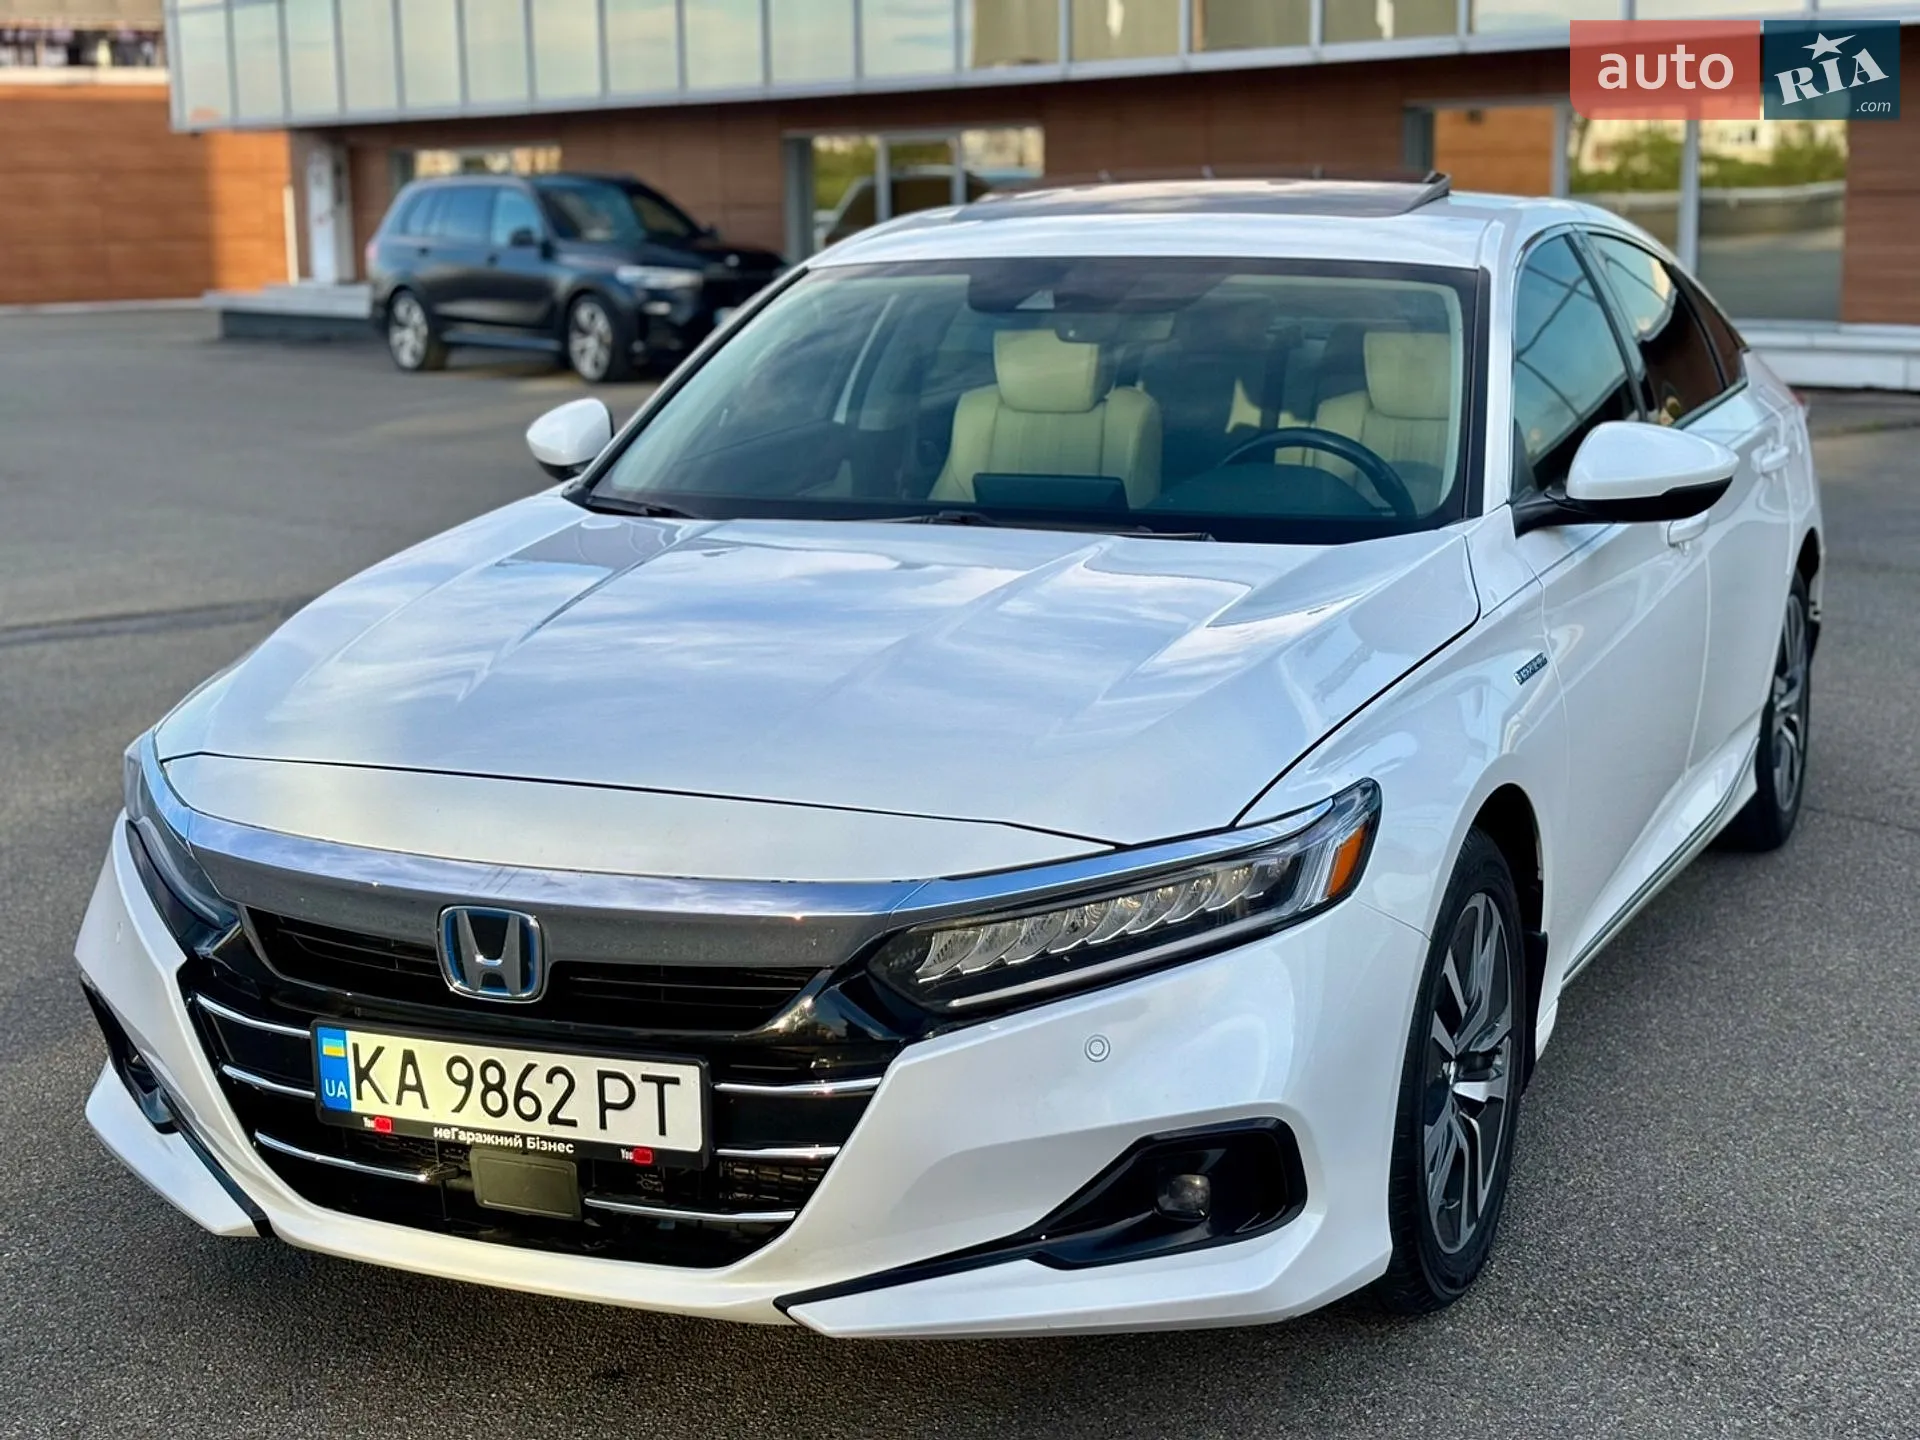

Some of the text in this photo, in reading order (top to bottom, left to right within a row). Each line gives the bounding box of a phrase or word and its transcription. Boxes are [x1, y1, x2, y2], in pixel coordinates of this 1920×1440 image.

[325, 1079, 348, 1100] UA
[352, 1042, 681, 1137] KA 9862 PT
[433, 1126, 575, 1154] неГаражний Бізнес
